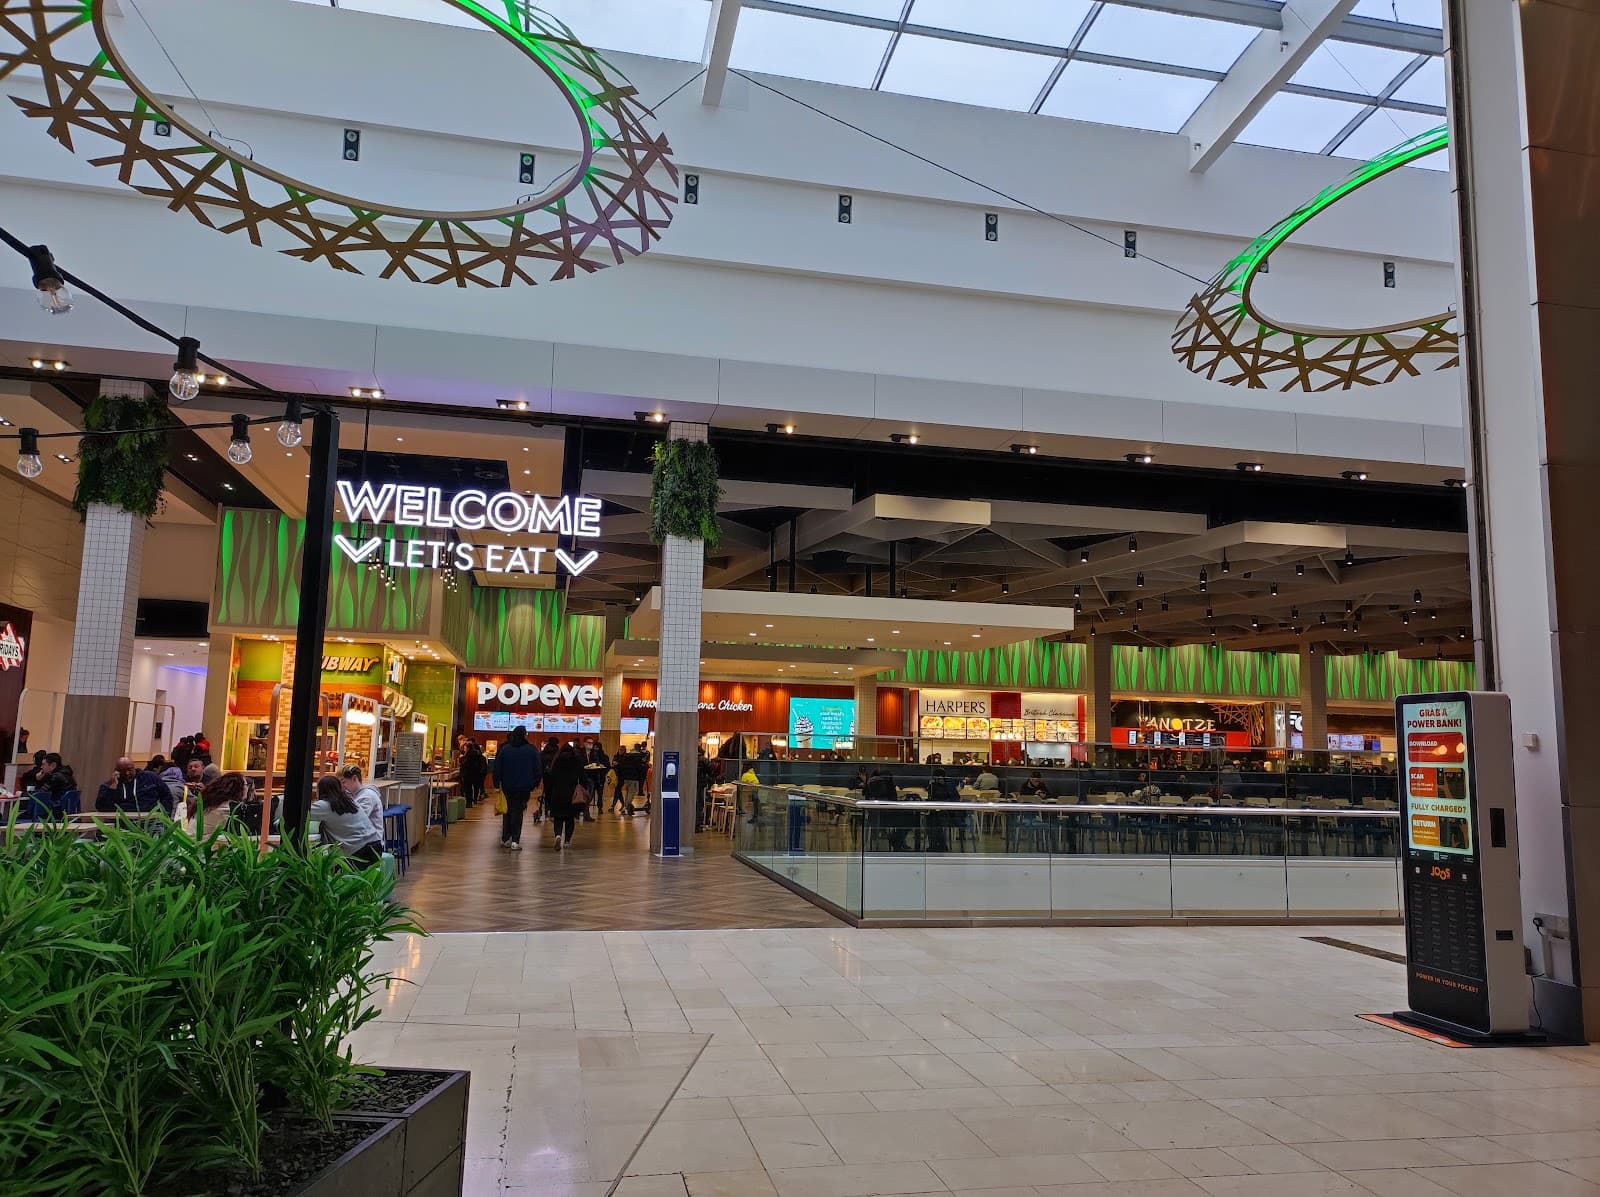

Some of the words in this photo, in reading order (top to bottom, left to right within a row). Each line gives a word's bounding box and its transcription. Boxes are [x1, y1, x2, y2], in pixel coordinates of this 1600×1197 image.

[336, 480, 602, 537] WELCOME
[388, 539, 474, 571] LET'S
[485, 544, 547, 575] EAT
[718, 699, 753, 711] Chicken
[926, 700, 986, 714] HARPER'S
[1419, 708, 1441, 717] GRAB
[1441, 708, 1448, 717] A
[1407, 719, 1436, 728] POWER
[1436, 719, 1462, 728] BANK!
[1411, 802, 1430, 811] FULLY
[1431, 804, 1467, 814] CHARGED?
[1412, 819, 1436, 828] RETURN
[1415, 972, 1434, 982] POWER
[1441, 979, 1457, 988] YOUR
[1457, 983, 1479, 993] POCKET
